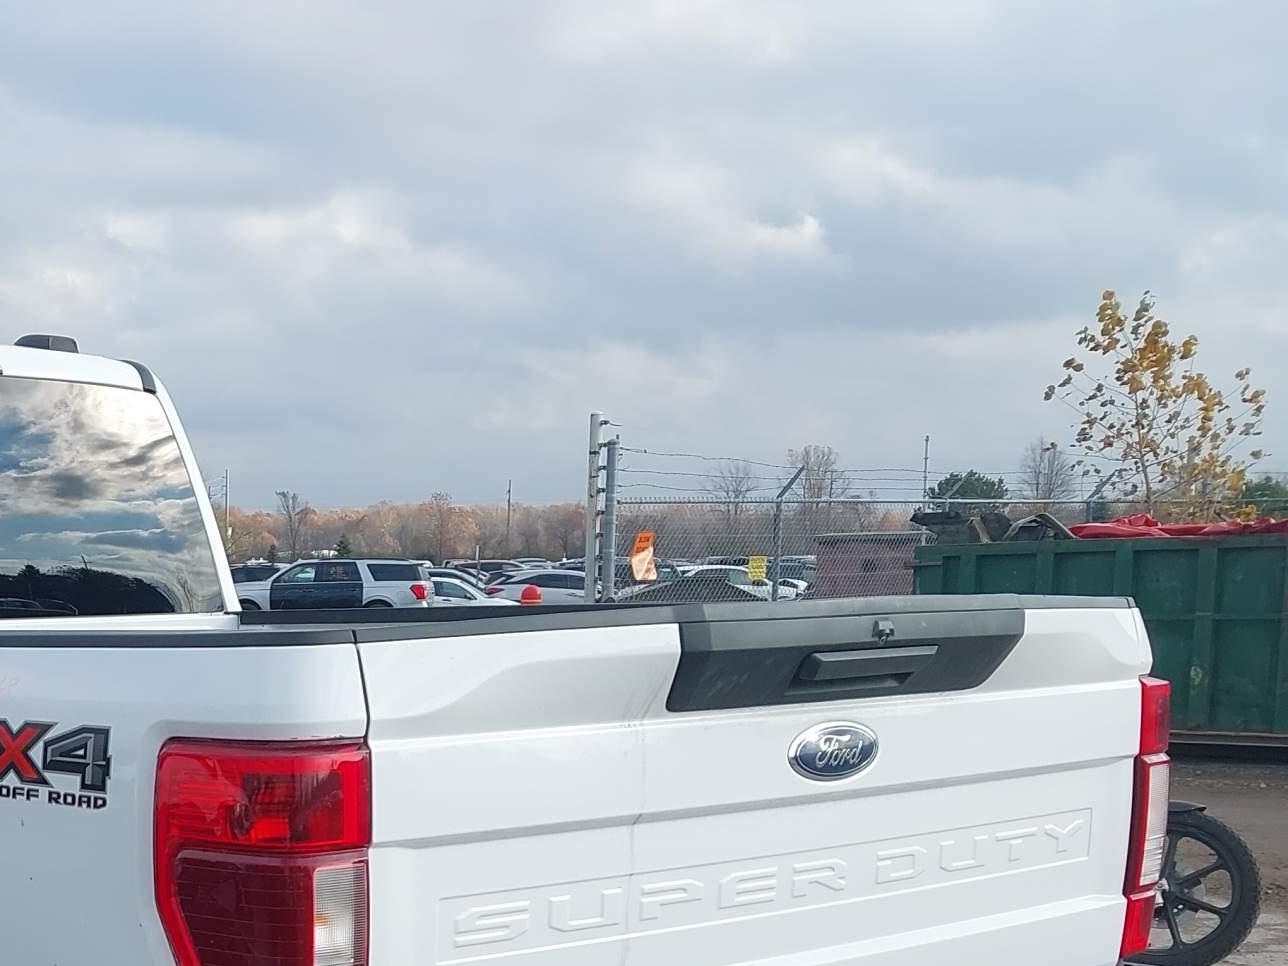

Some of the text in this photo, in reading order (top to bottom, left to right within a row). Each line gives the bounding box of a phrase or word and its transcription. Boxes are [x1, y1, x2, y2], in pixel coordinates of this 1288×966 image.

[815, 734, 863, 768] Ford
[47, 791, 107, 810] ROAD
[453, 817, 1085, 949] SUPER DUTY
